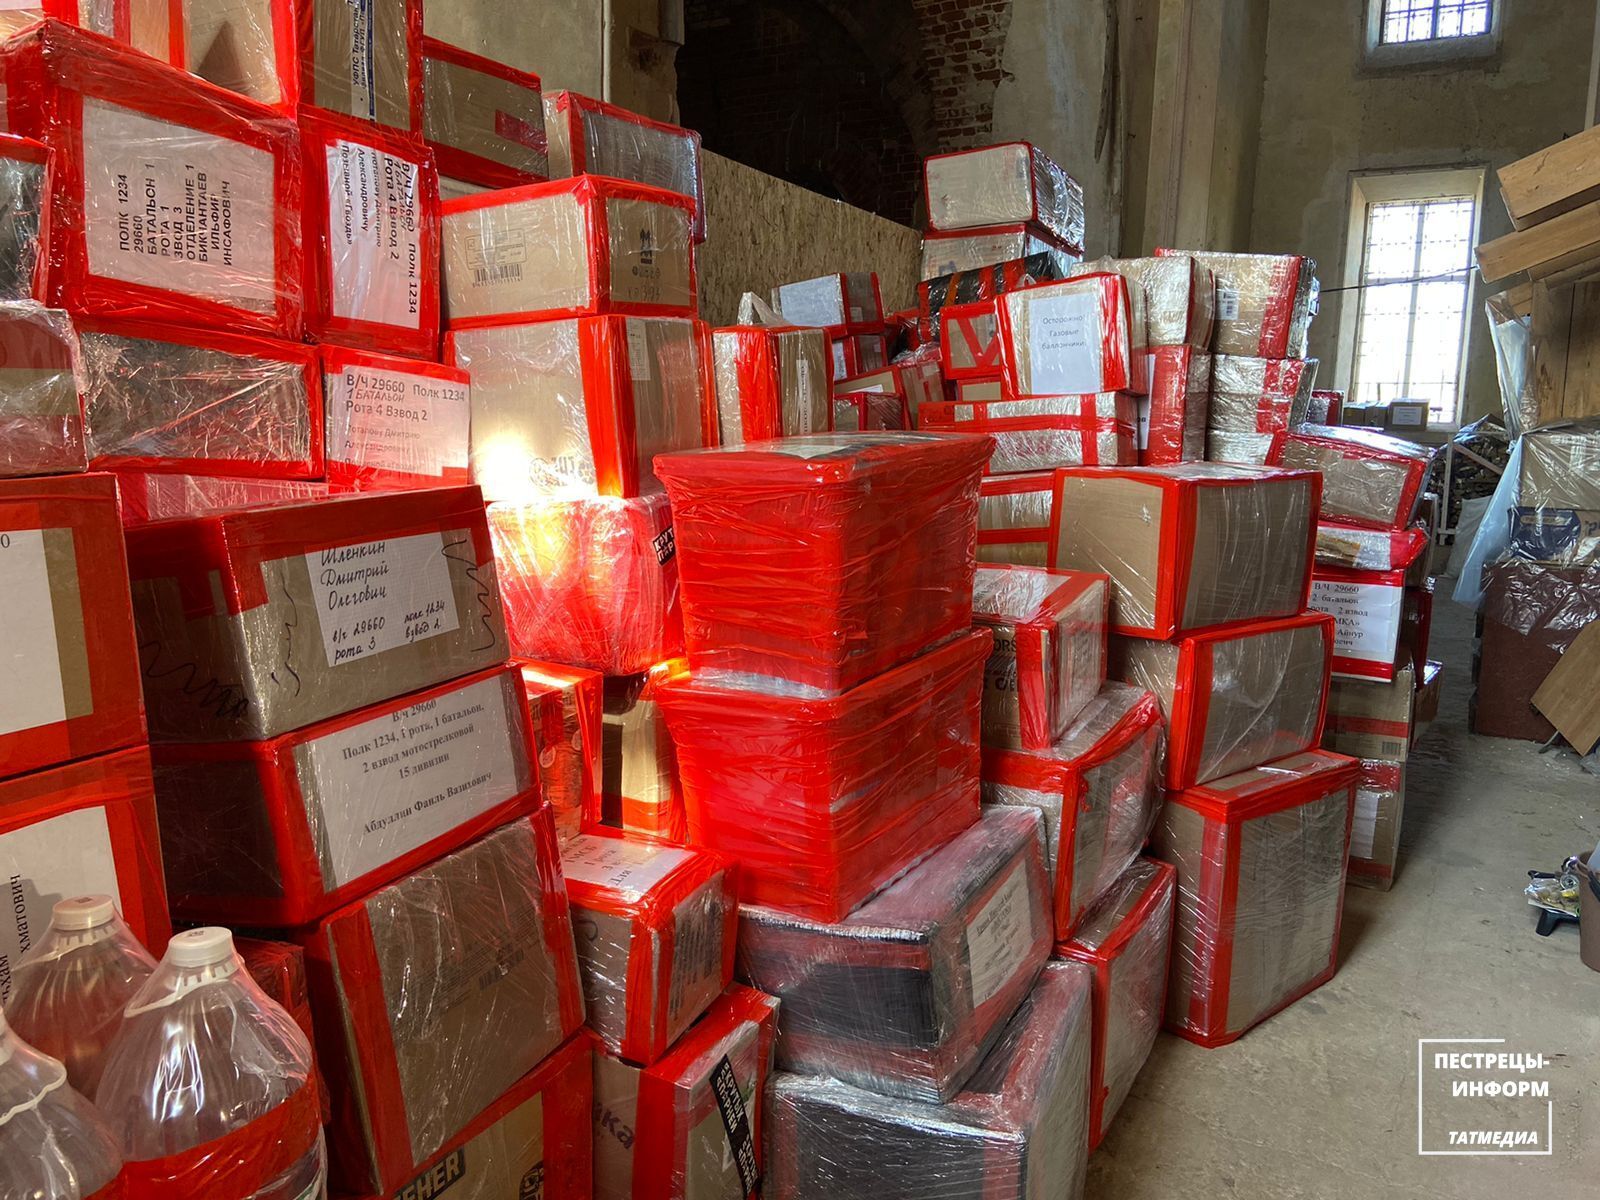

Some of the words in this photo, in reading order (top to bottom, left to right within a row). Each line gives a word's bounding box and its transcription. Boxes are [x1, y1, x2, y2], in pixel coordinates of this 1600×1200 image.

[384, 158, 395, 189] Рота
[118, 174, 128, 204] 1234
[358, 148, 370, 232] Александровичу
[389, 195, 397, 203] 4
[146, 178, 157, 254] БАТАЛЬОН
[186, 178, 196, 260] ОТДЕЛЕНИЕ
[198, 172, 208, 262] БИКЧАНТАЕВ
[211, 193, 220, 250] ИЛЬФИР
[223, 181, 232, 266] ИНСАФОВИЧ
[405, 192, 415, 232] 29660
[119, 212, 130, 251] ПОЛК
[133, 215, 143, 253] 29660
[161, 221, 171, 257] РОТА
[174, 222, 184, 258] ЗВОД
[408, 243, 416, 278] Полк
[409, 283, 418, 313] 1234
[347, 375, 368, 389] В/Ч
[372, 378, 405, 393] 29660
[413, 384, 439, 398] Полк
[443, 389, 465, 401] 1234
[346, 401, 372, 413] Рота
[375, 405, 383, 415] 4
[386, 405, 419, 421] Взвод
[422, 410, 428, 420] 2
[321, 561, 389, 586] Дмитрий
[1335, 584, 1360, 593] 29660
[329, 585, 387, 610] Олегович
[354, 617, 385, 635] 29660
[335, 644, 362, 665] рота
[411, 699, 437, 717] 29660
[342, 743, 371, 760] Полк
[362, 762, 370, 774] 2
[371, 754, 400, 770] взвод
[401, 723, 474, 758] мотострелковой
[399, 767, 410, 780] 15
[412, 753, 450, 775] дивизии
[363, 807, 412, 835] Абдуллин
